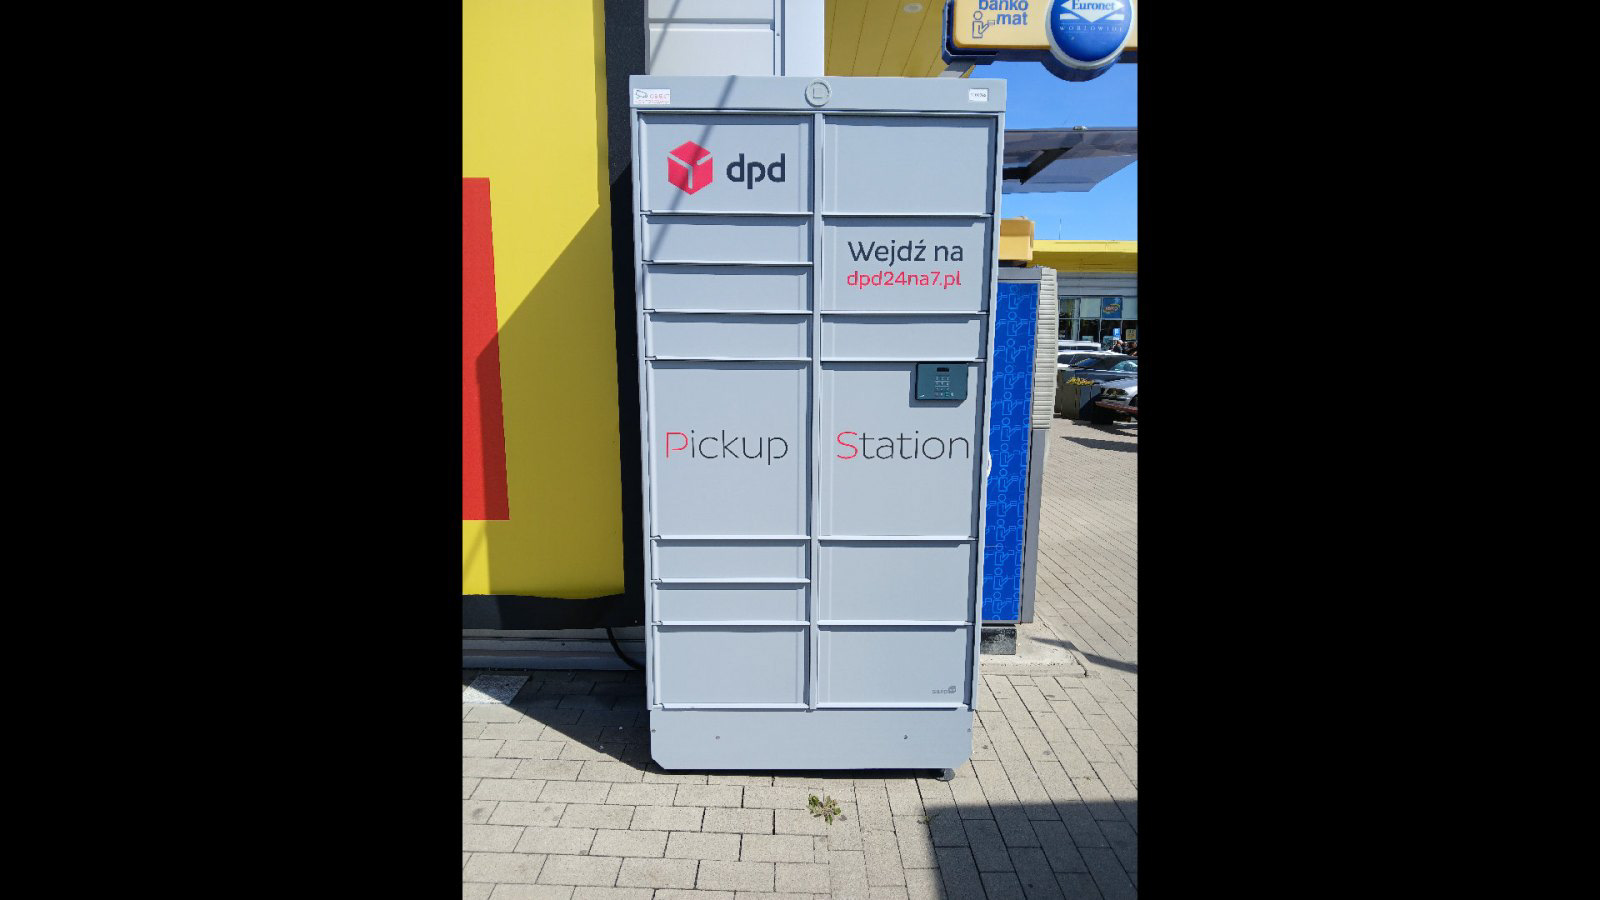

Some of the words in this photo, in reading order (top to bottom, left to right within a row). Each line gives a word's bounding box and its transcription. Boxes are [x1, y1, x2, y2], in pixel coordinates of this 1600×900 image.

[979, 0, 1029, 11] banko
[1071, 0, 1115, 10] Euronet
[996, 12, 1028, 25] mat
[726, 153, 785, 189] dpd
[847, 239, 926, 267] Wejdź
[934, 245, 963, 261] na
[847, 270, 961, 289] dpd24na7.pl
[665, 429, 788, 465] Pickup
[836, 430, 969, 459] Station
